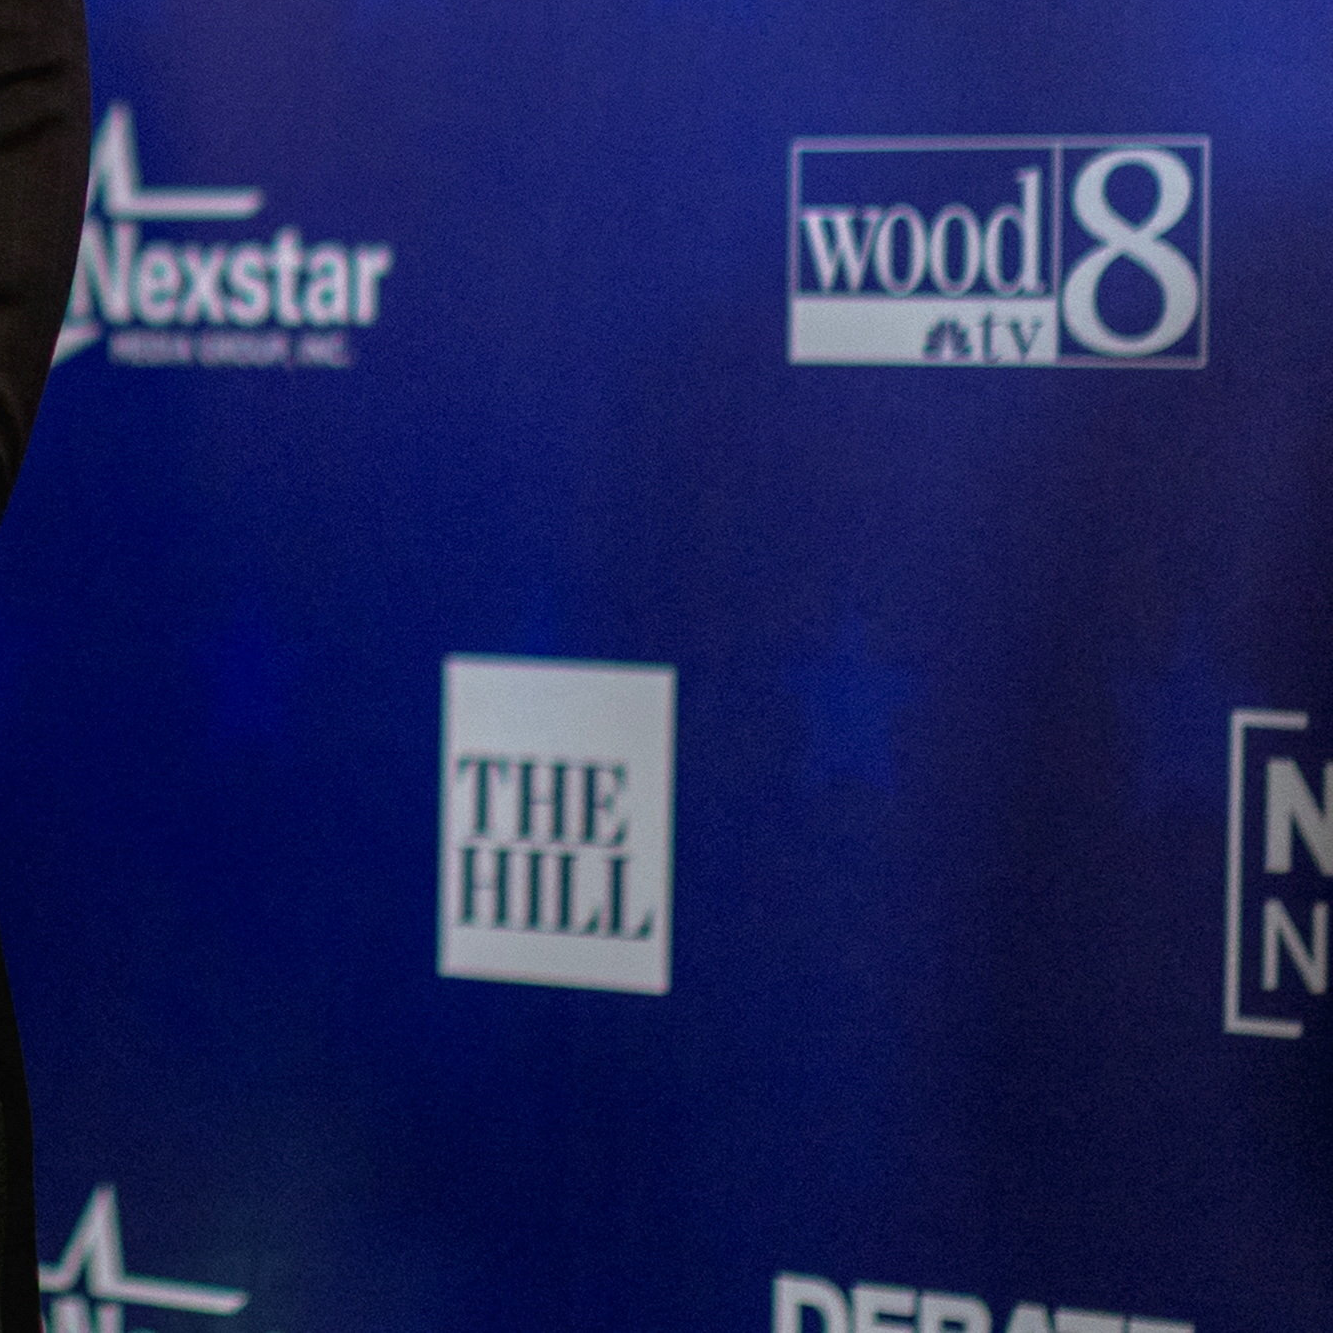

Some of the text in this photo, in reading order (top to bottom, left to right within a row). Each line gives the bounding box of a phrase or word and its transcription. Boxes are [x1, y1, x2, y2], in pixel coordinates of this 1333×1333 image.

[72, 221, 393, 327] Nexstar
[800, 146, 1200, 358] wood 8
[457, 753, 627, 848] THE
[457, 844, 656, 943] HILL
